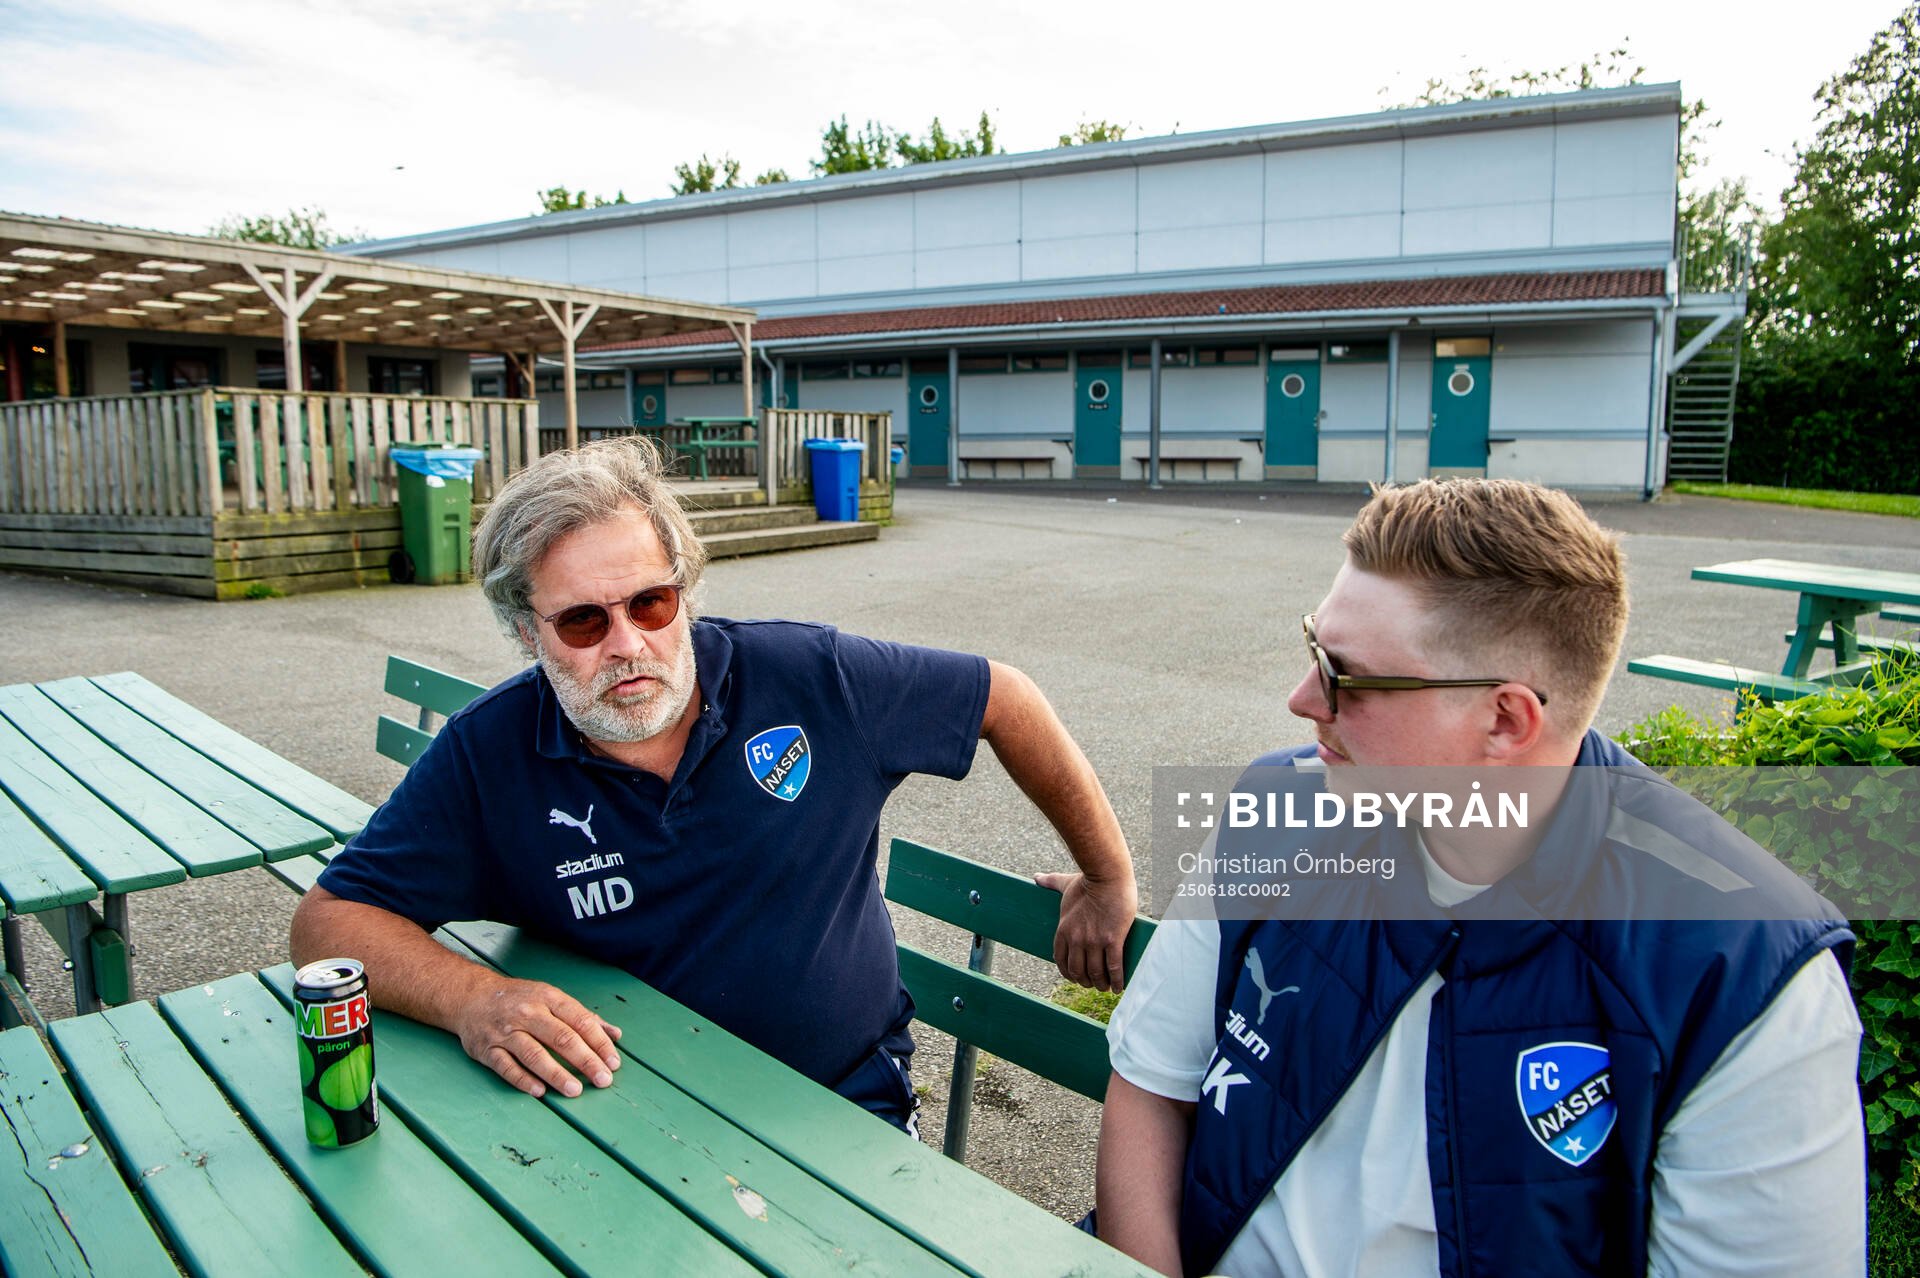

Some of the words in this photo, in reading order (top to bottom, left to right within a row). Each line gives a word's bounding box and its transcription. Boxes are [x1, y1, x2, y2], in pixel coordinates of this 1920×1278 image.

[751, 742, 774, 764] FC
[765, 740, 804, 791] NÄSET
[555, 852, 625, 879] stadium
[567, 876, 634, 920] MD
[295, 997, 369, 1037] MER
[1225, 1009, 1271, 1062] dium
[317, 1040, 350, 1054] päron
[1201, 1046, 1252, 1116] K
[1528, 1061, 1560, 1091] FC
[1536, 1073, 1611, 1140] NÄSET
